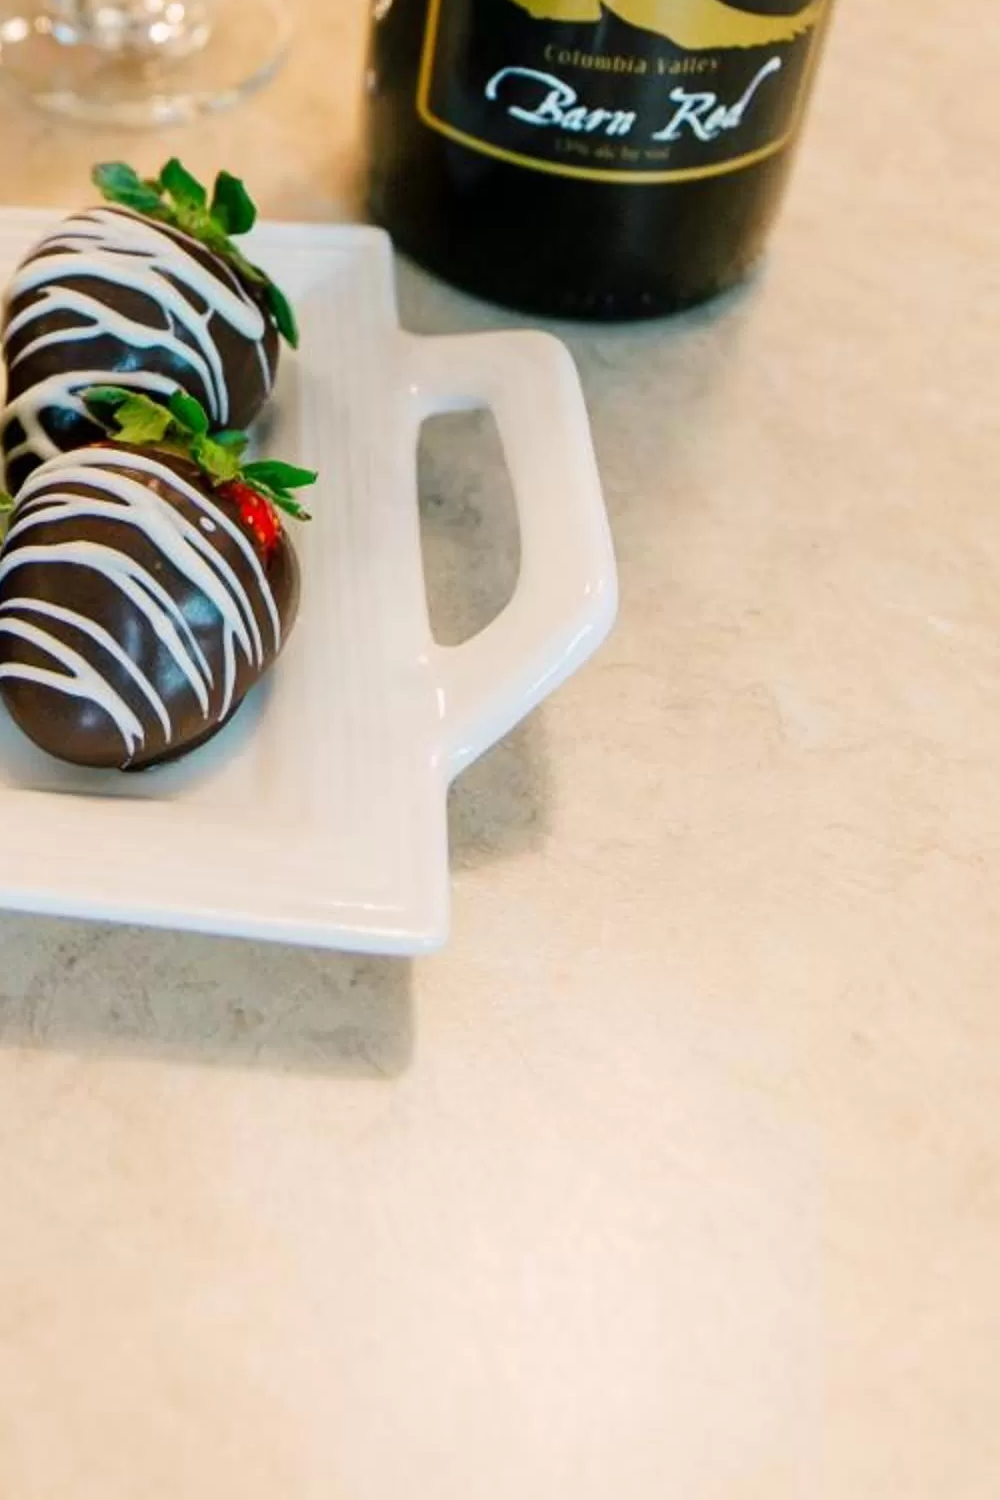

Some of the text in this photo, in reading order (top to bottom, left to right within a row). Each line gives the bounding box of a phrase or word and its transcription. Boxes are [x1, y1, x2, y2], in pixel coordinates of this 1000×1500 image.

[544, 43, 647, 75] Columbia
[485, 56, 782, 141] Barn Red
